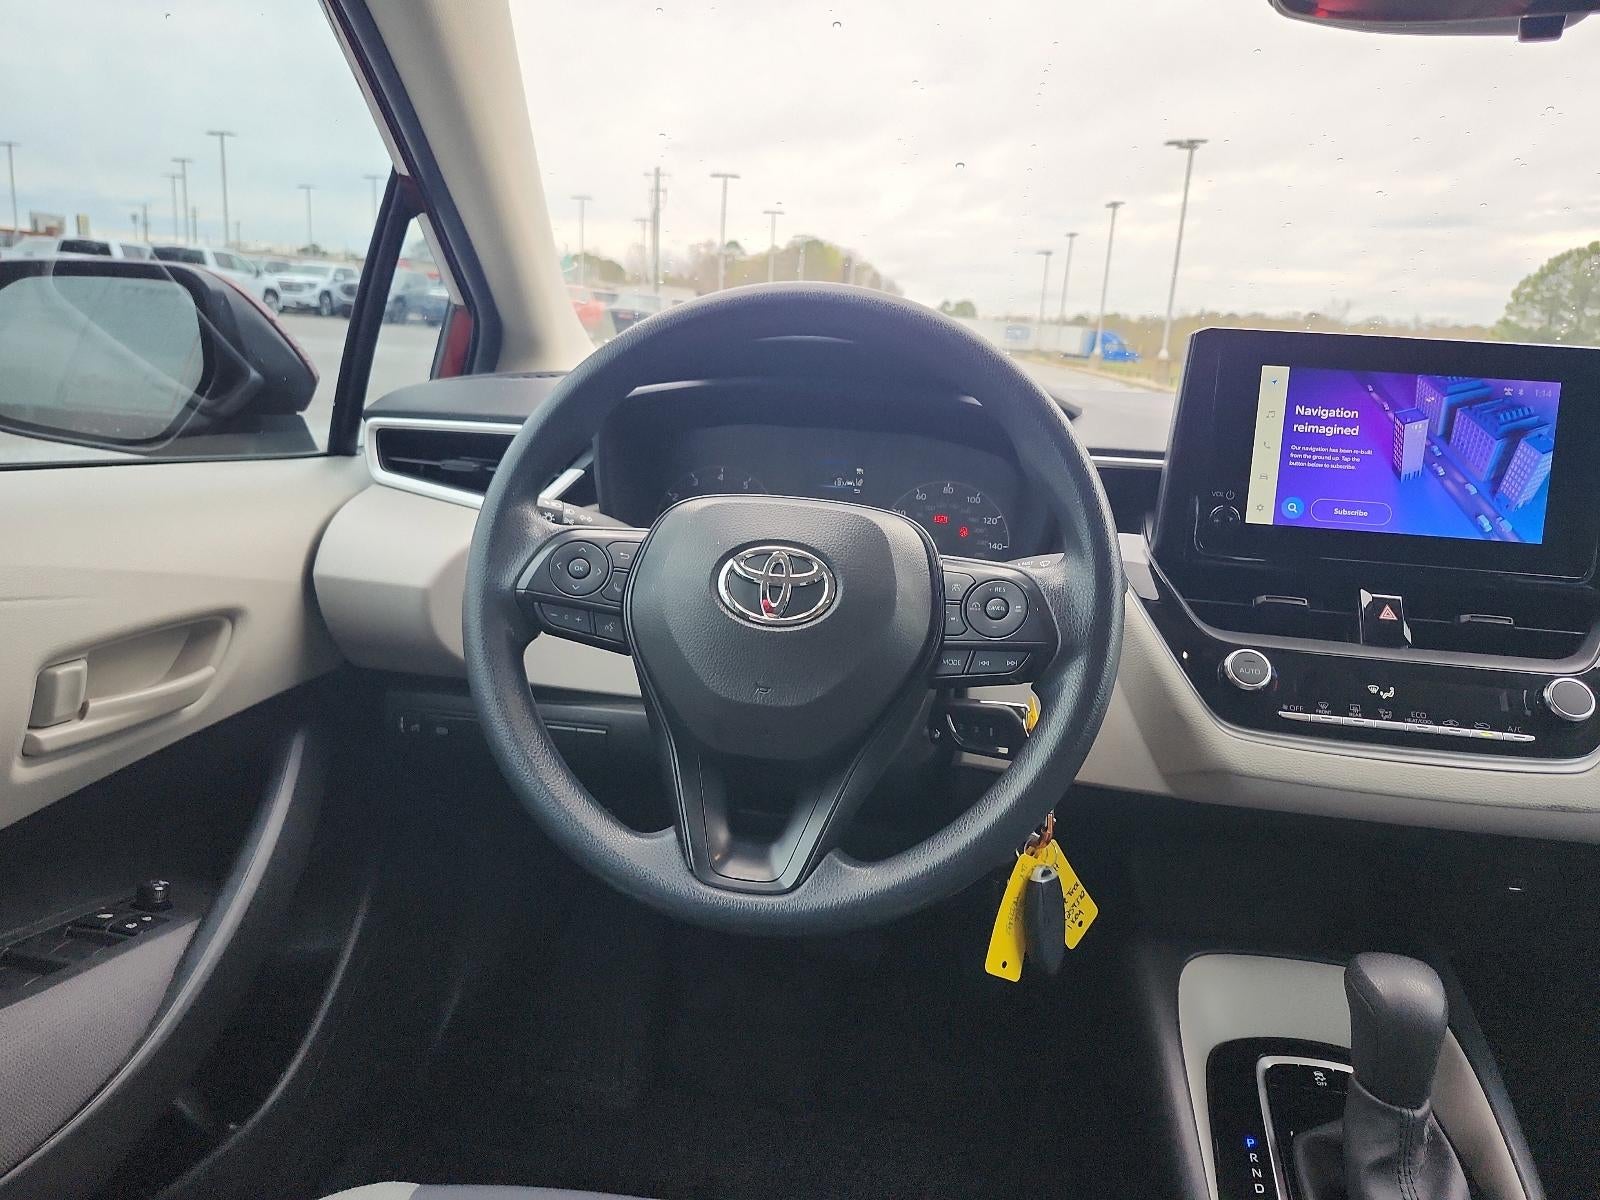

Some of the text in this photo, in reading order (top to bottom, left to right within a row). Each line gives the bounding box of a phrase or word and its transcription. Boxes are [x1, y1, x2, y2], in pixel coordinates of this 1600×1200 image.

[1295, 404, 1359, 419] Navigation
[1293, 422, 1359, 437] reimagined
[916, 493, 927, 501] 60
[967, 496, 980, 504] 100
[1333, 507, 1369, 517] Subscribe
[983, 517, 998, 525] 120
[988, 542, 1003, 550] 140
[942, 658, 961, 666] MODE
[1240, 667, 1261, 675] AUTO
[1411, 711, 1427, 719] ECO
[1246, 1138, 1255, 1148] P
[1249, 1152, 1259, 1163] R
[1251, 1167, 1262, 1178] N
[1254, 1183, 1265, 1194] D
